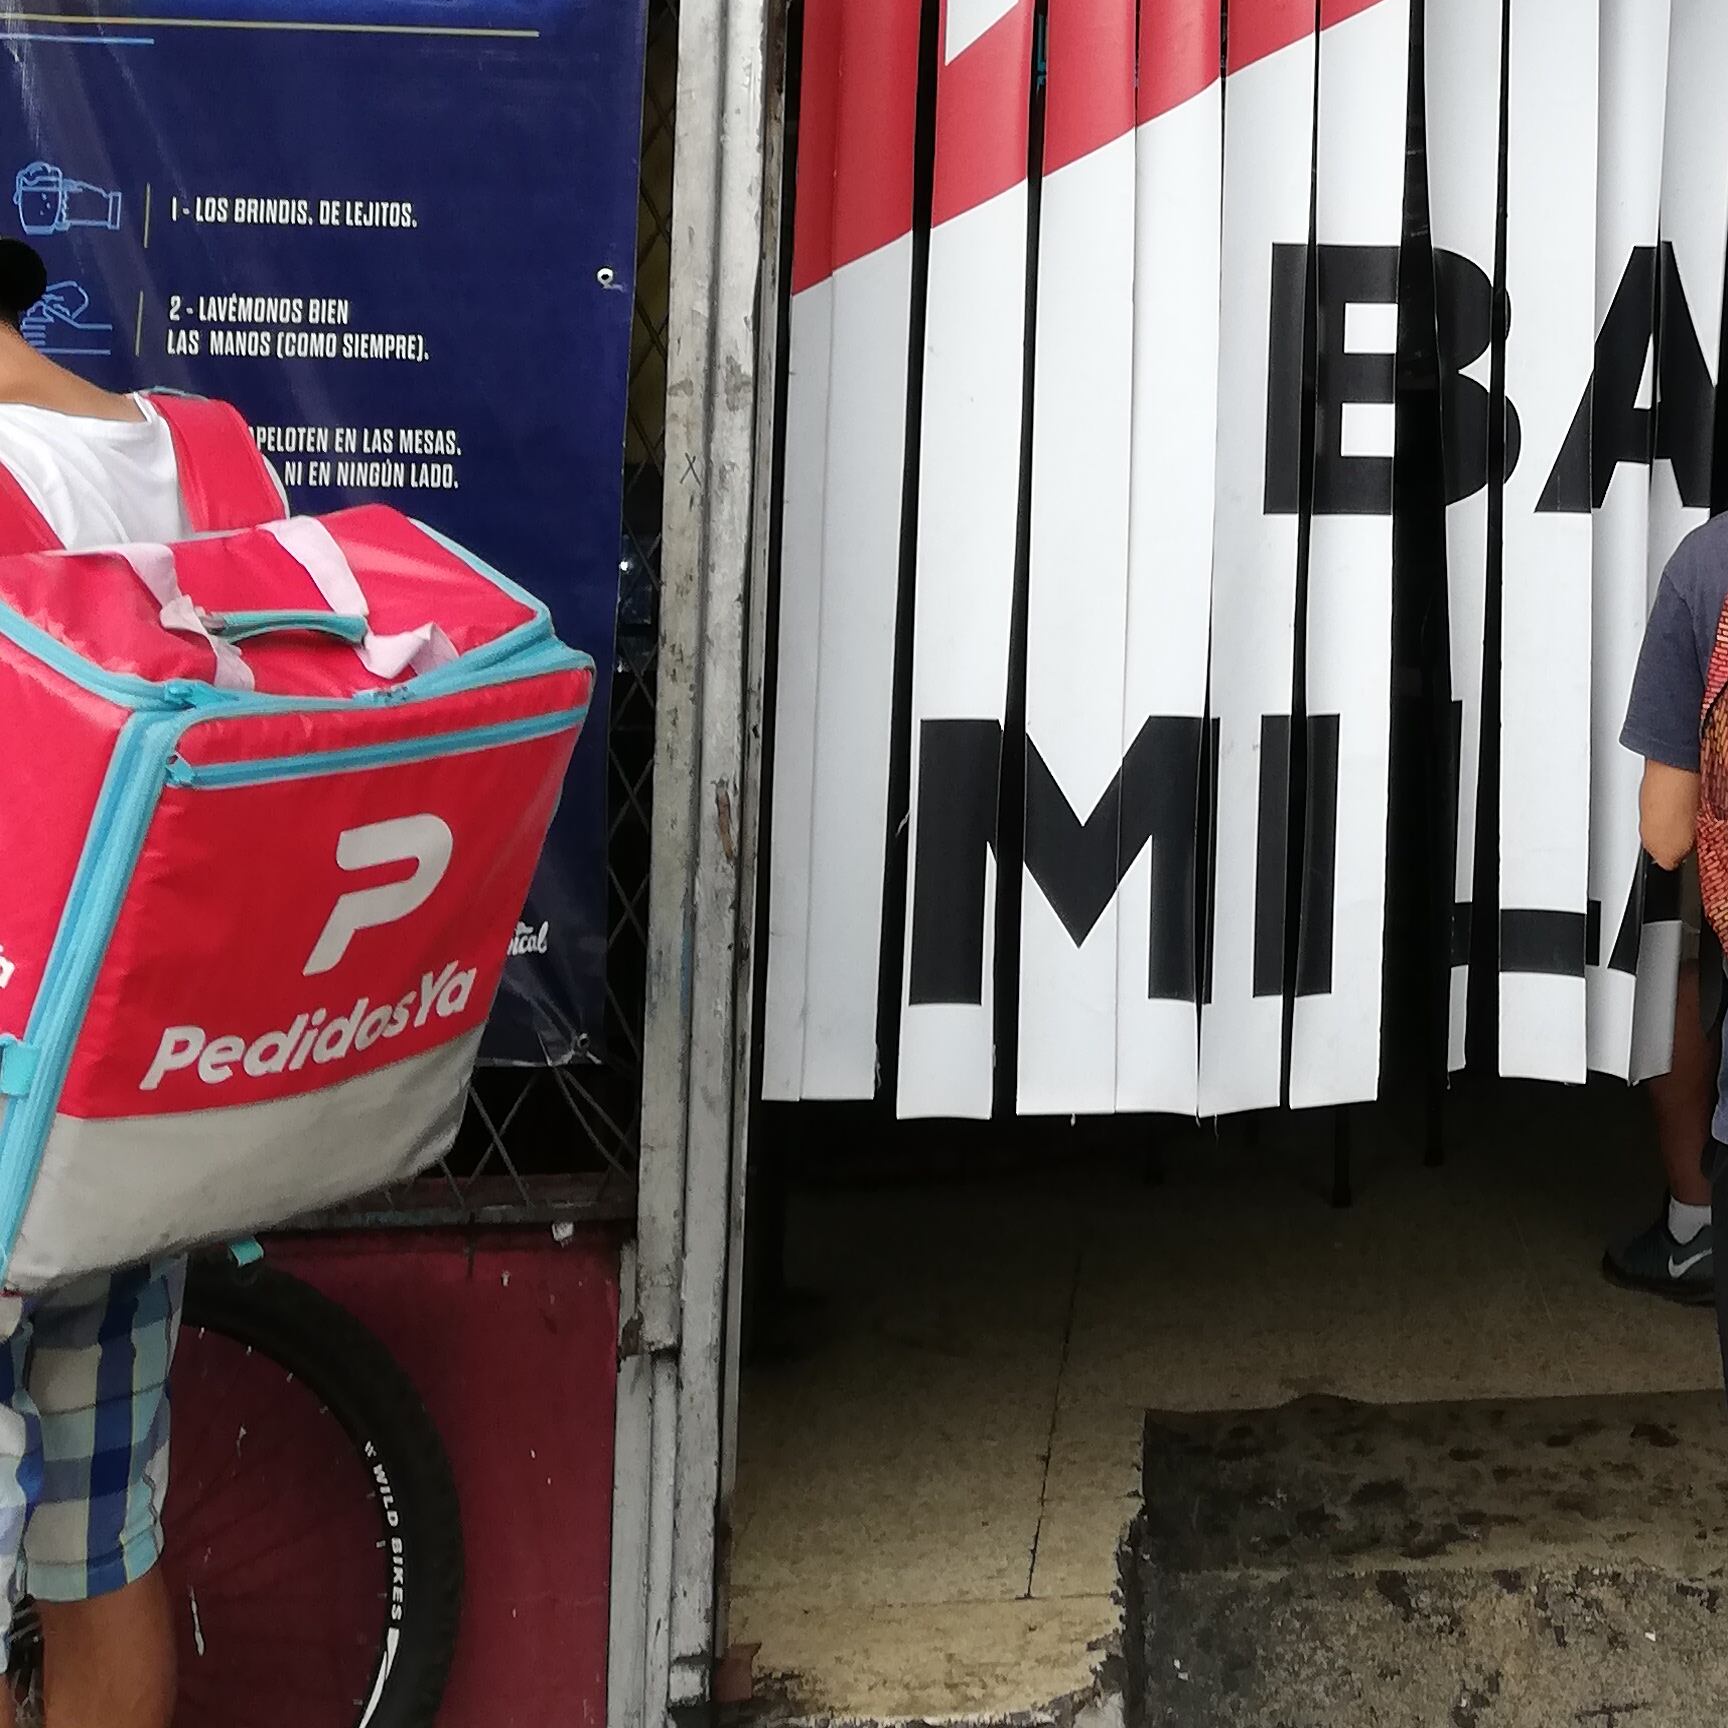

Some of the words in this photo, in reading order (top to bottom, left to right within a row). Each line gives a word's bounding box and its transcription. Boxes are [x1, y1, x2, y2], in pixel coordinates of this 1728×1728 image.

[196, 196, 228, 223] LOS
[319, 200, 340, 225] DE
[346, 201, 417, 228] LEJITOS.
[169, 295, 181, 321] 2
[198, 293, 303, 323] LAVÉMONOS
[308, 298, 349, 324] BIEN
[167, 329, 199, 355] LAS
[210, 330, 271, 357] MANOS
[276, 331, 337, 359] (COMO
[342, 333, 430, 362] SIEMPRE).
[335, 427, 357, 453] EN
[363, 428, 394, 454] LAS
[399, 429, 462, 456] MESAS.
[308, 461, 331, 487] EN
[336, 458, 405, 488] NINGÚN
[410, 462, 459, 489] LADO.
[140, 959, 477, 1091] PedidosYa
[373, 1464, 399, 1527] WILD
[391, 1537, 404, 1621] BIKES
